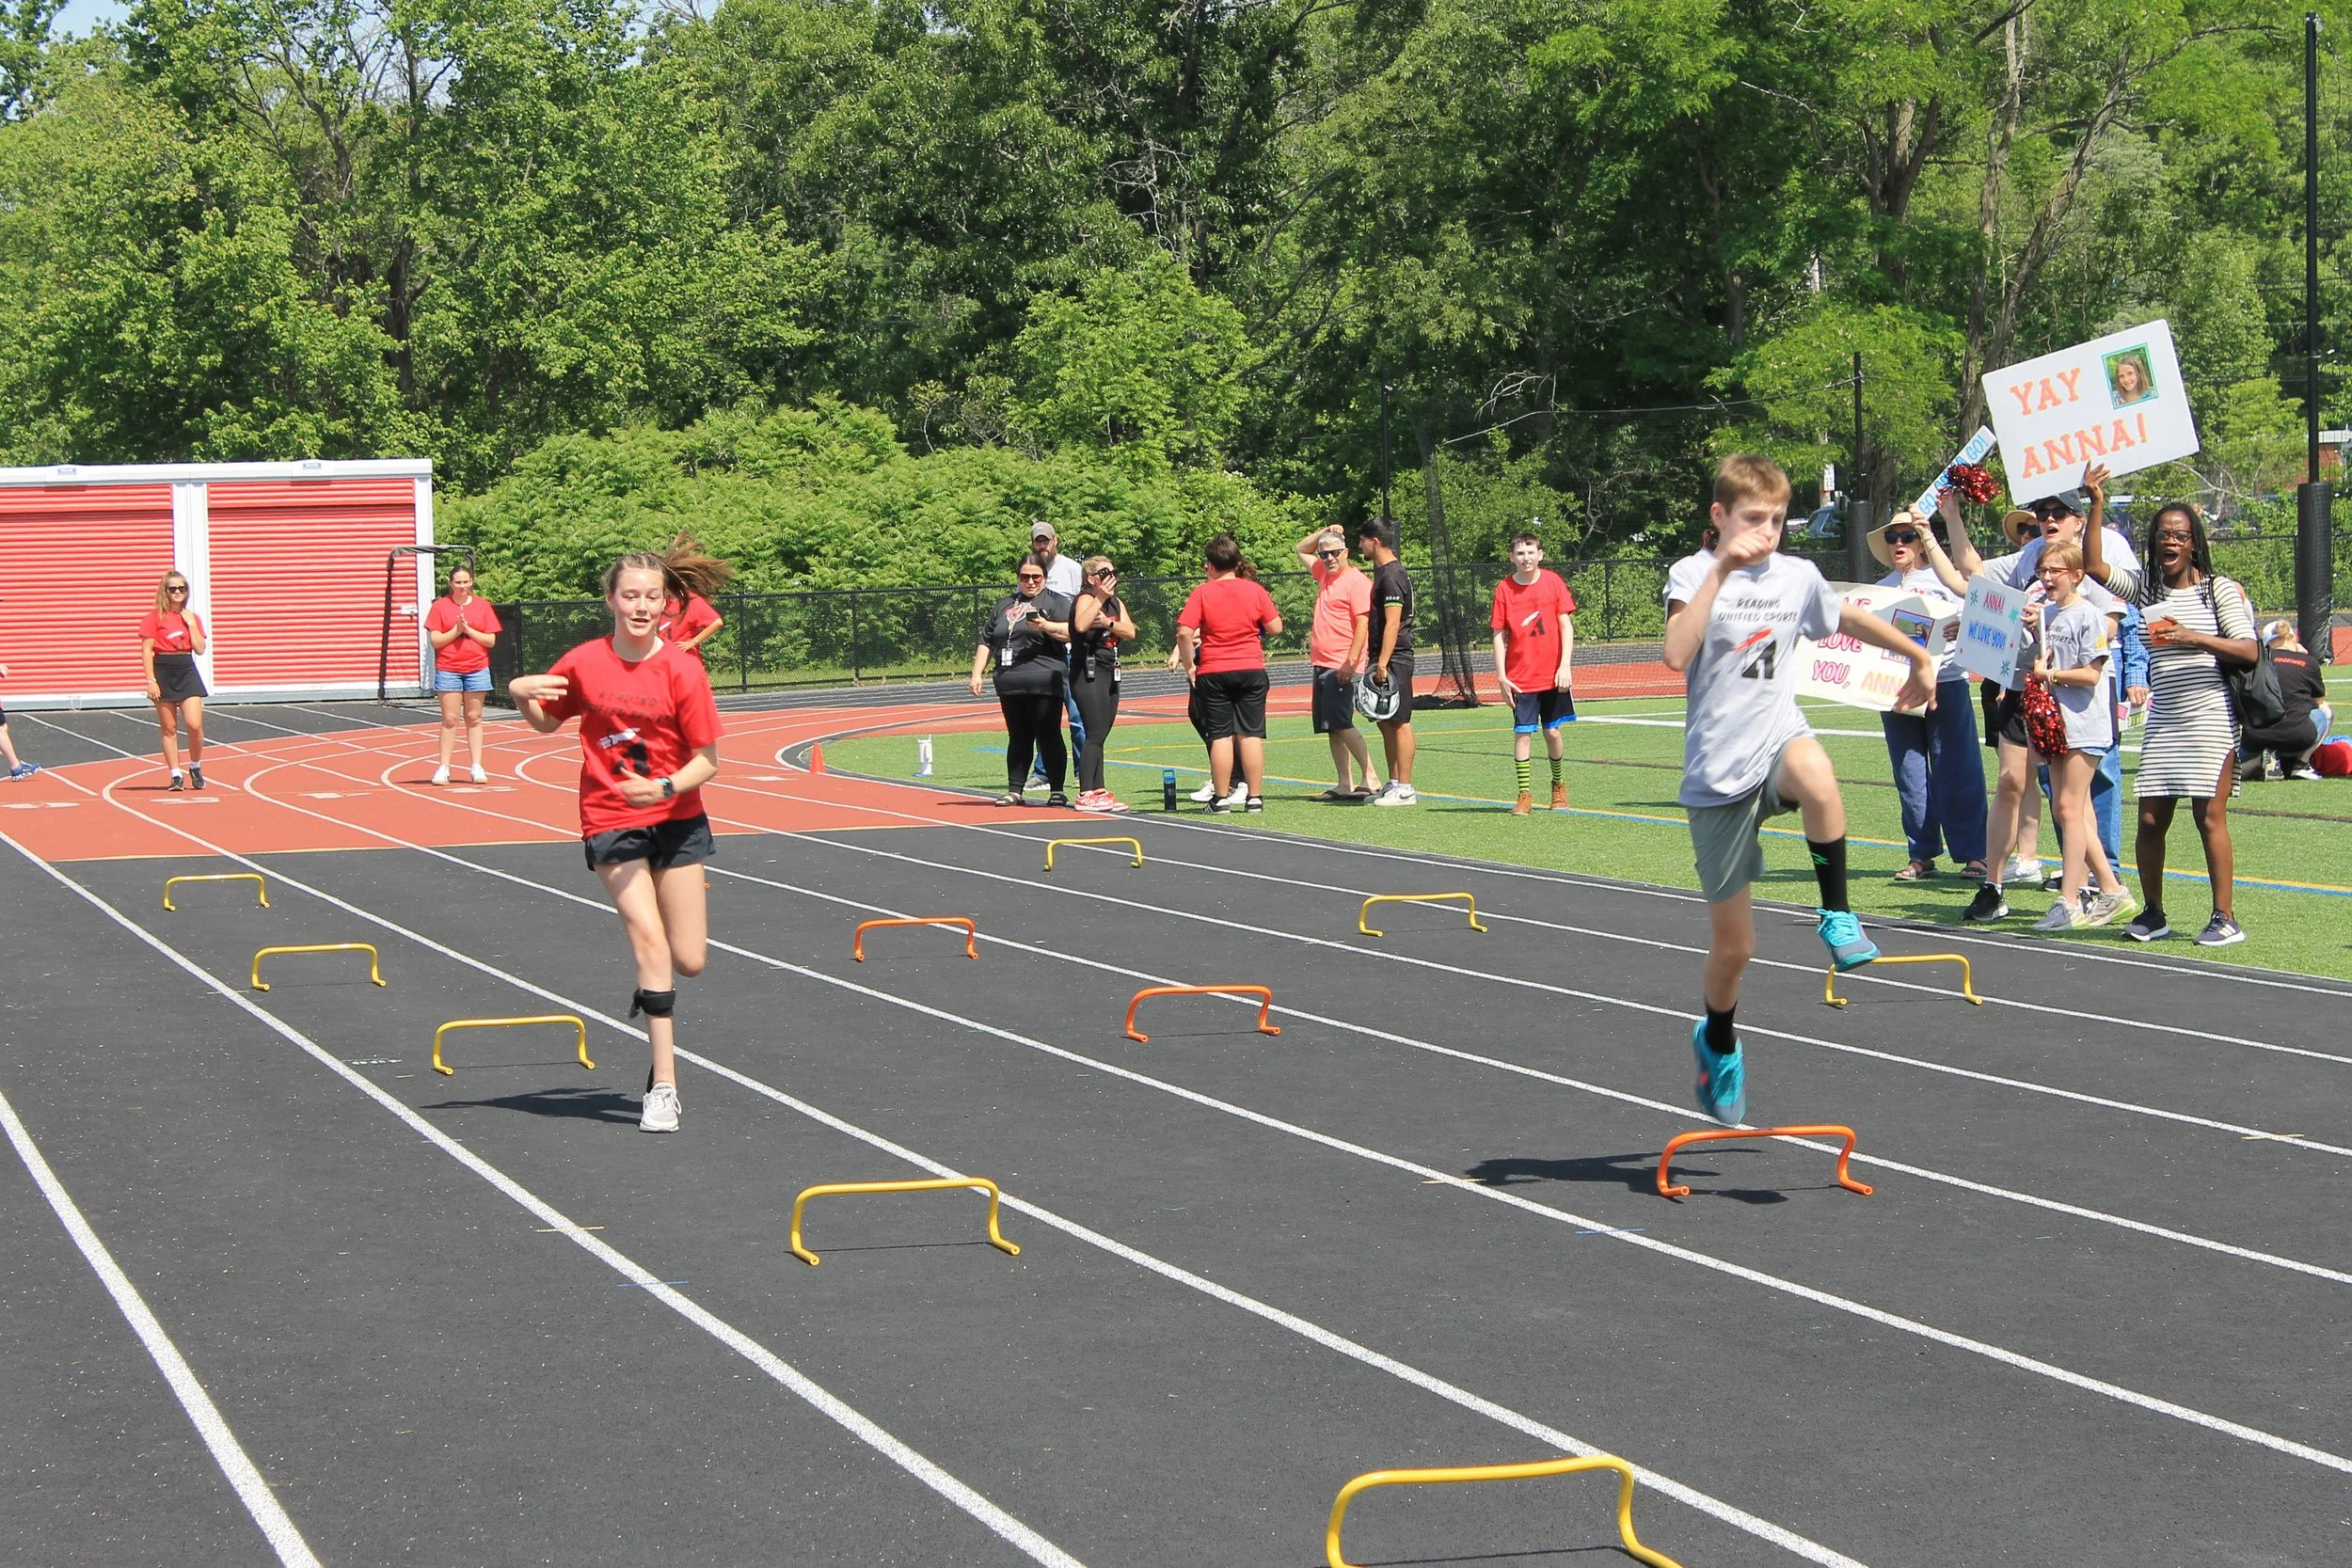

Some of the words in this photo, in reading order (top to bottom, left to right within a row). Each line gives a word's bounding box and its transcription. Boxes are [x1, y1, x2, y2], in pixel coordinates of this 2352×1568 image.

[2010, 367, 2081, 416] YAY
[2021, 412, 2148, 479] ANNA!
[1918, 492, 1937, 515] GO
[1965, 434, 1989, 461] GO!
[1736, 597, 1781, 609] READING
[1983, 592, 2005, 614] ANNA!
[1717, 610, 1761, 622] UNIFIED
[1763, 610, 1798, 623] SPORTS
[1818, 631, 1862, 652] LOVE
[1968, 621, 1979, 639] WE
[1978, 625, 1992, 644] LOVE
[1812, 659, 1851, 689] YOU,
[1861, 670, 1904, 698] ANN
